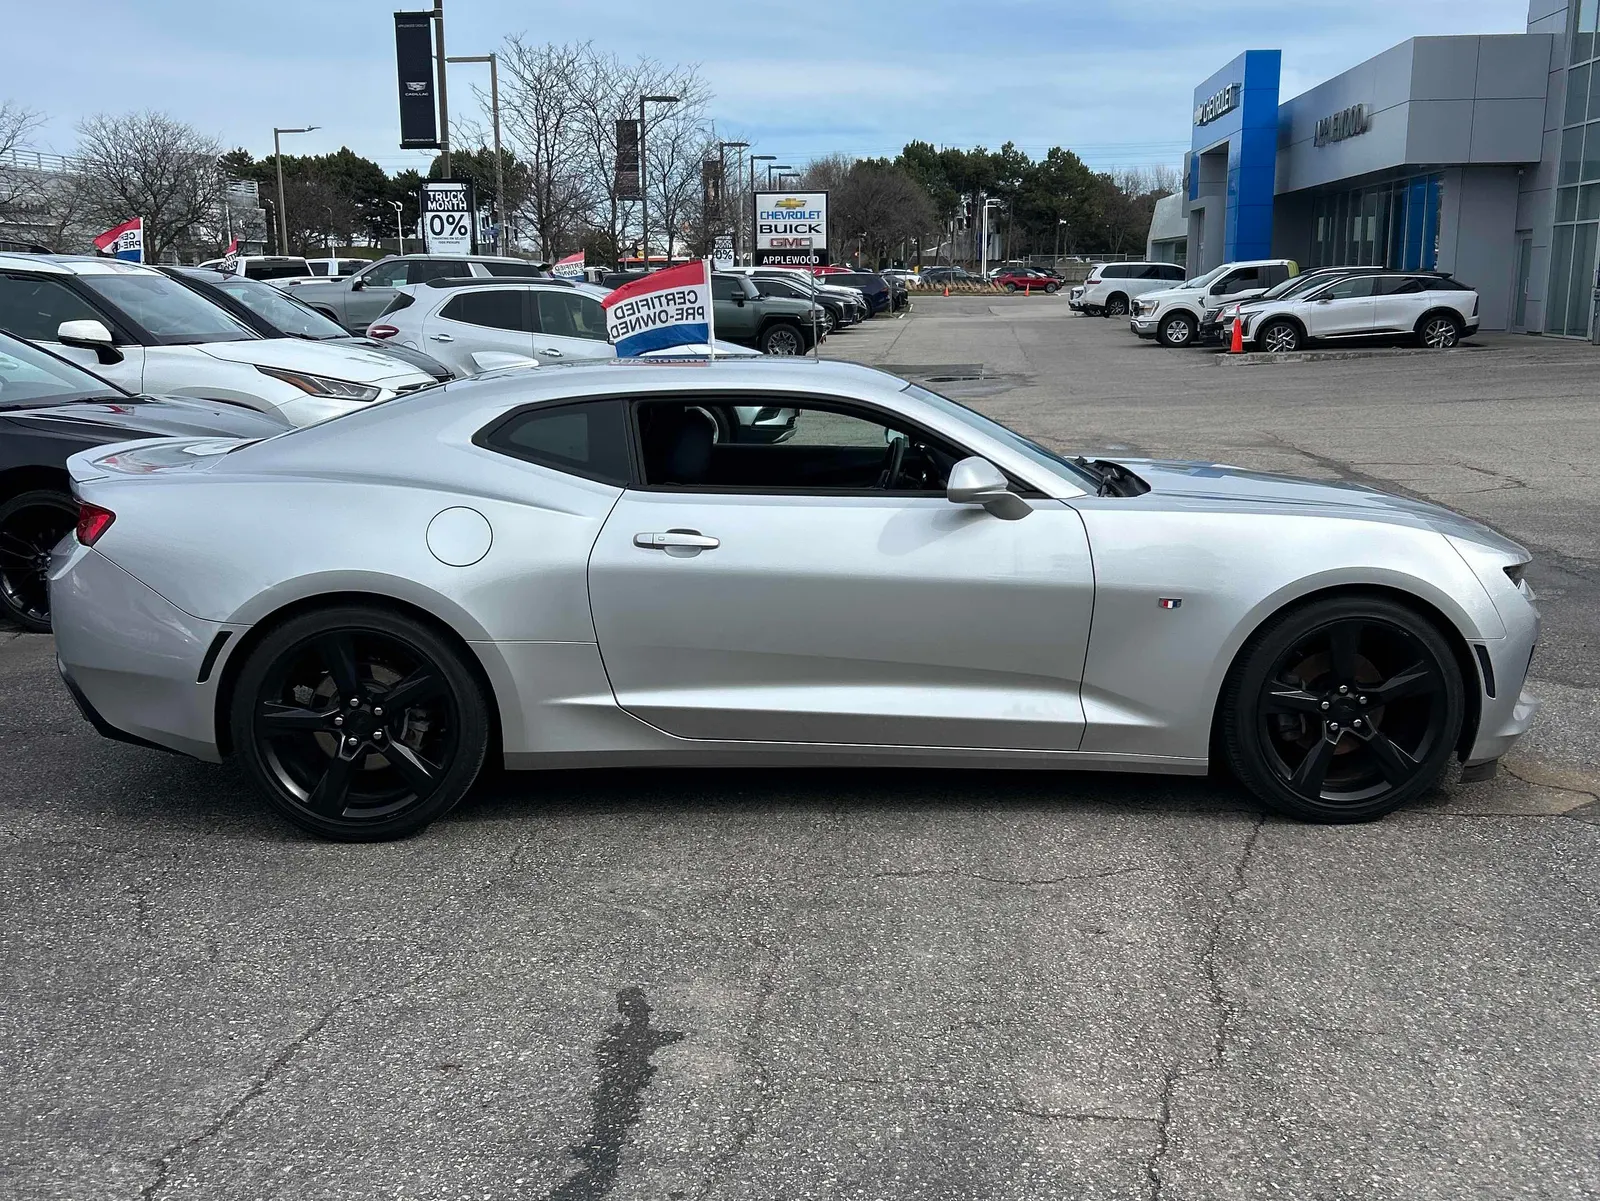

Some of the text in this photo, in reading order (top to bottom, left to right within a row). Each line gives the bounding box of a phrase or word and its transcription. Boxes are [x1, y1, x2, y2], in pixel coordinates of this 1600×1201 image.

[1202, 83, 1240, 122] CHEVROLET
[1314, 103, 1367, 147] APPLEWOOD
[428, 191, 465, 201] TRUCK
[428, 201, 467, 211] MONTH
[760, 210, 822, 220] CHEVROLET
[429, 214, 468, 236] 0%
[759, 224, 822, 234] BUICK
[770, 237, 812, 247] GMC
[715, 250, 733, 260] 0%
